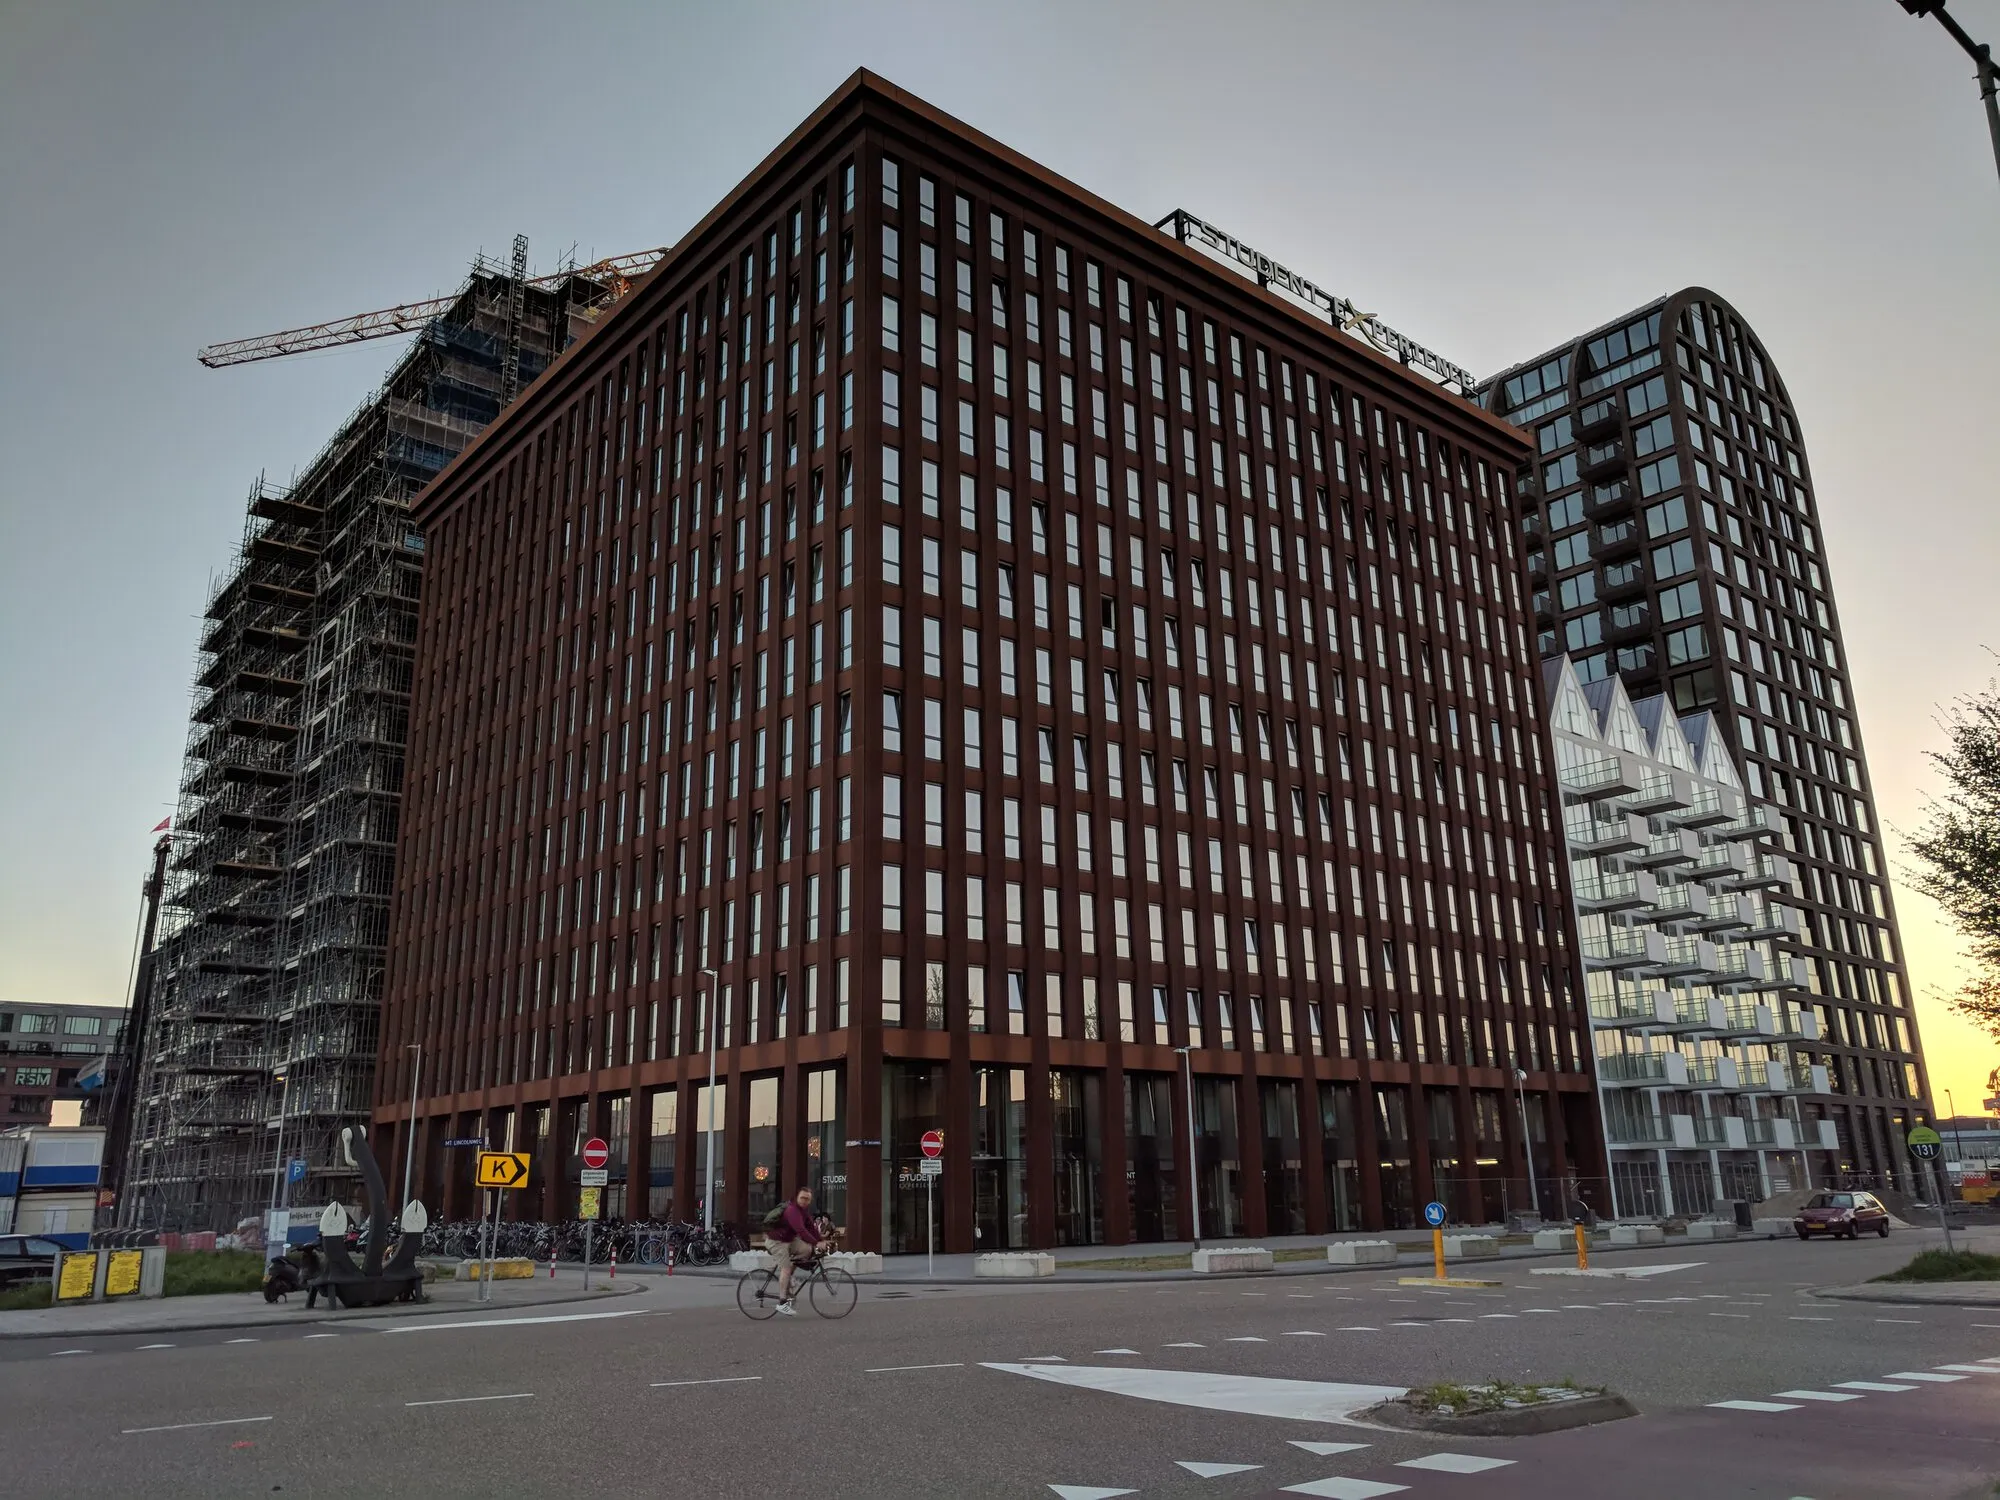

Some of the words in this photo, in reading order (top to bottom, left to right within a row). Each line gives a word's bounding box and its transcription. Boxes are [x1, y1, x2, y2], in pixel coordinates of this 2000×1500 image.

[1200, 221, 1321, 304] STUDENT
[1332, 297, 1475, 389] EXPERIENCE
[15, 1073, 51, 1086] RSM
[1916, 1144, 1934, 1156] 131
[293, 1166, 301, 1177] P
[492, 1160, 507, 1179] K
[822, 1175, 847, 1184] STUDEN
